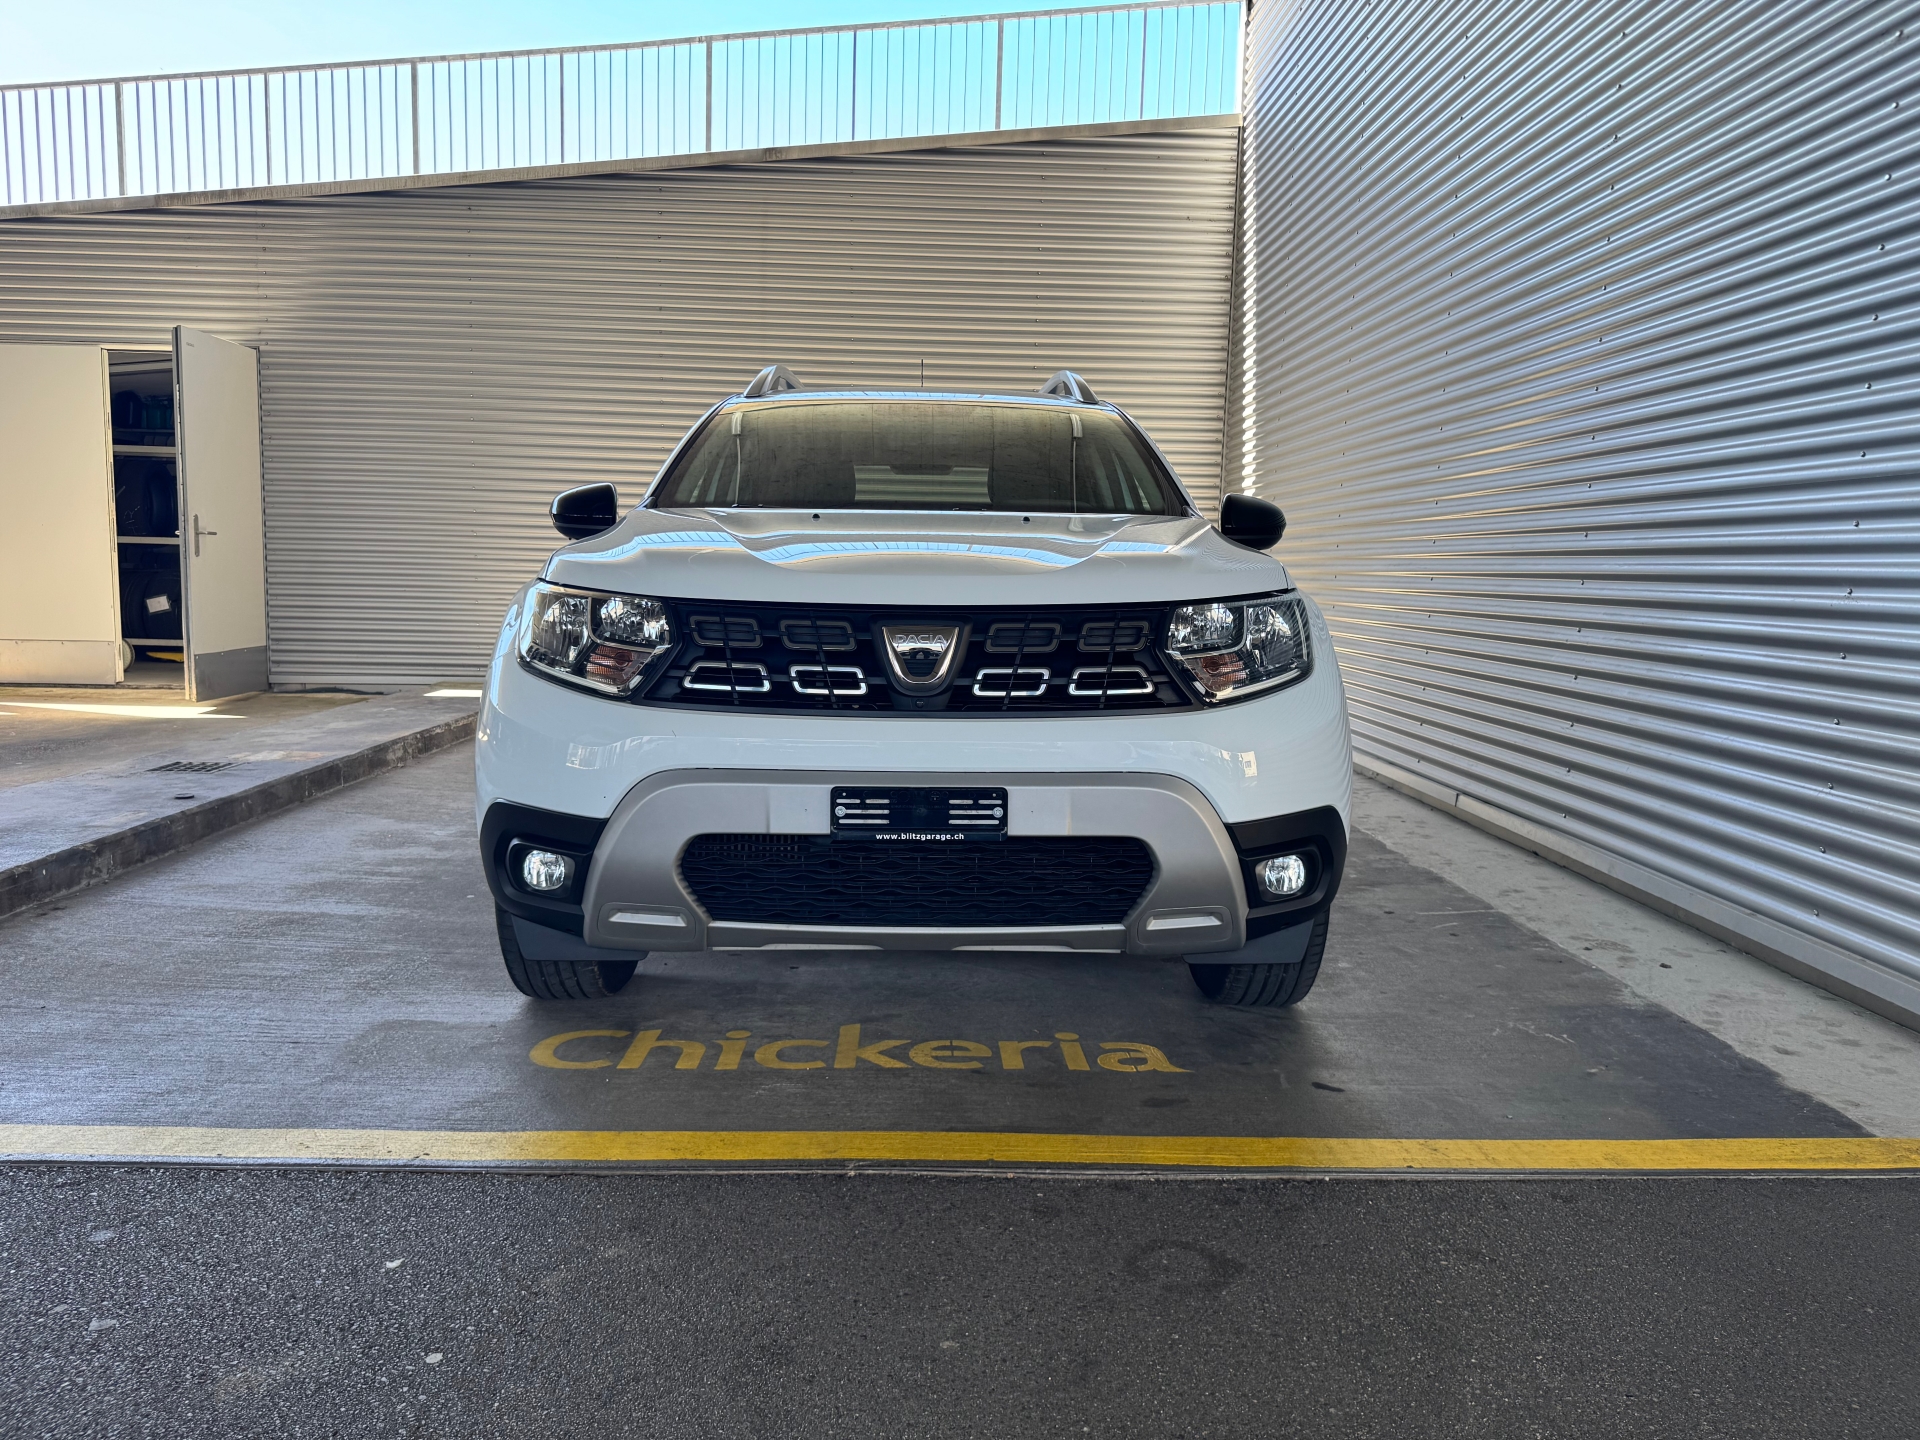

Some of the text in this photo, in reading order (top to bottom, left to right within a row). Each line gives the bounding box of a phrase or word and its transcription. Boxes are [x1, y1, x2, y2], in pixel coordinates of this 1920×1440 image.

[894, 634, 946, 645] DACIA
[876, 832, 965, 841] www.blitzgarage.ch
[529, 1024, 1193, 1073] Chickeria
